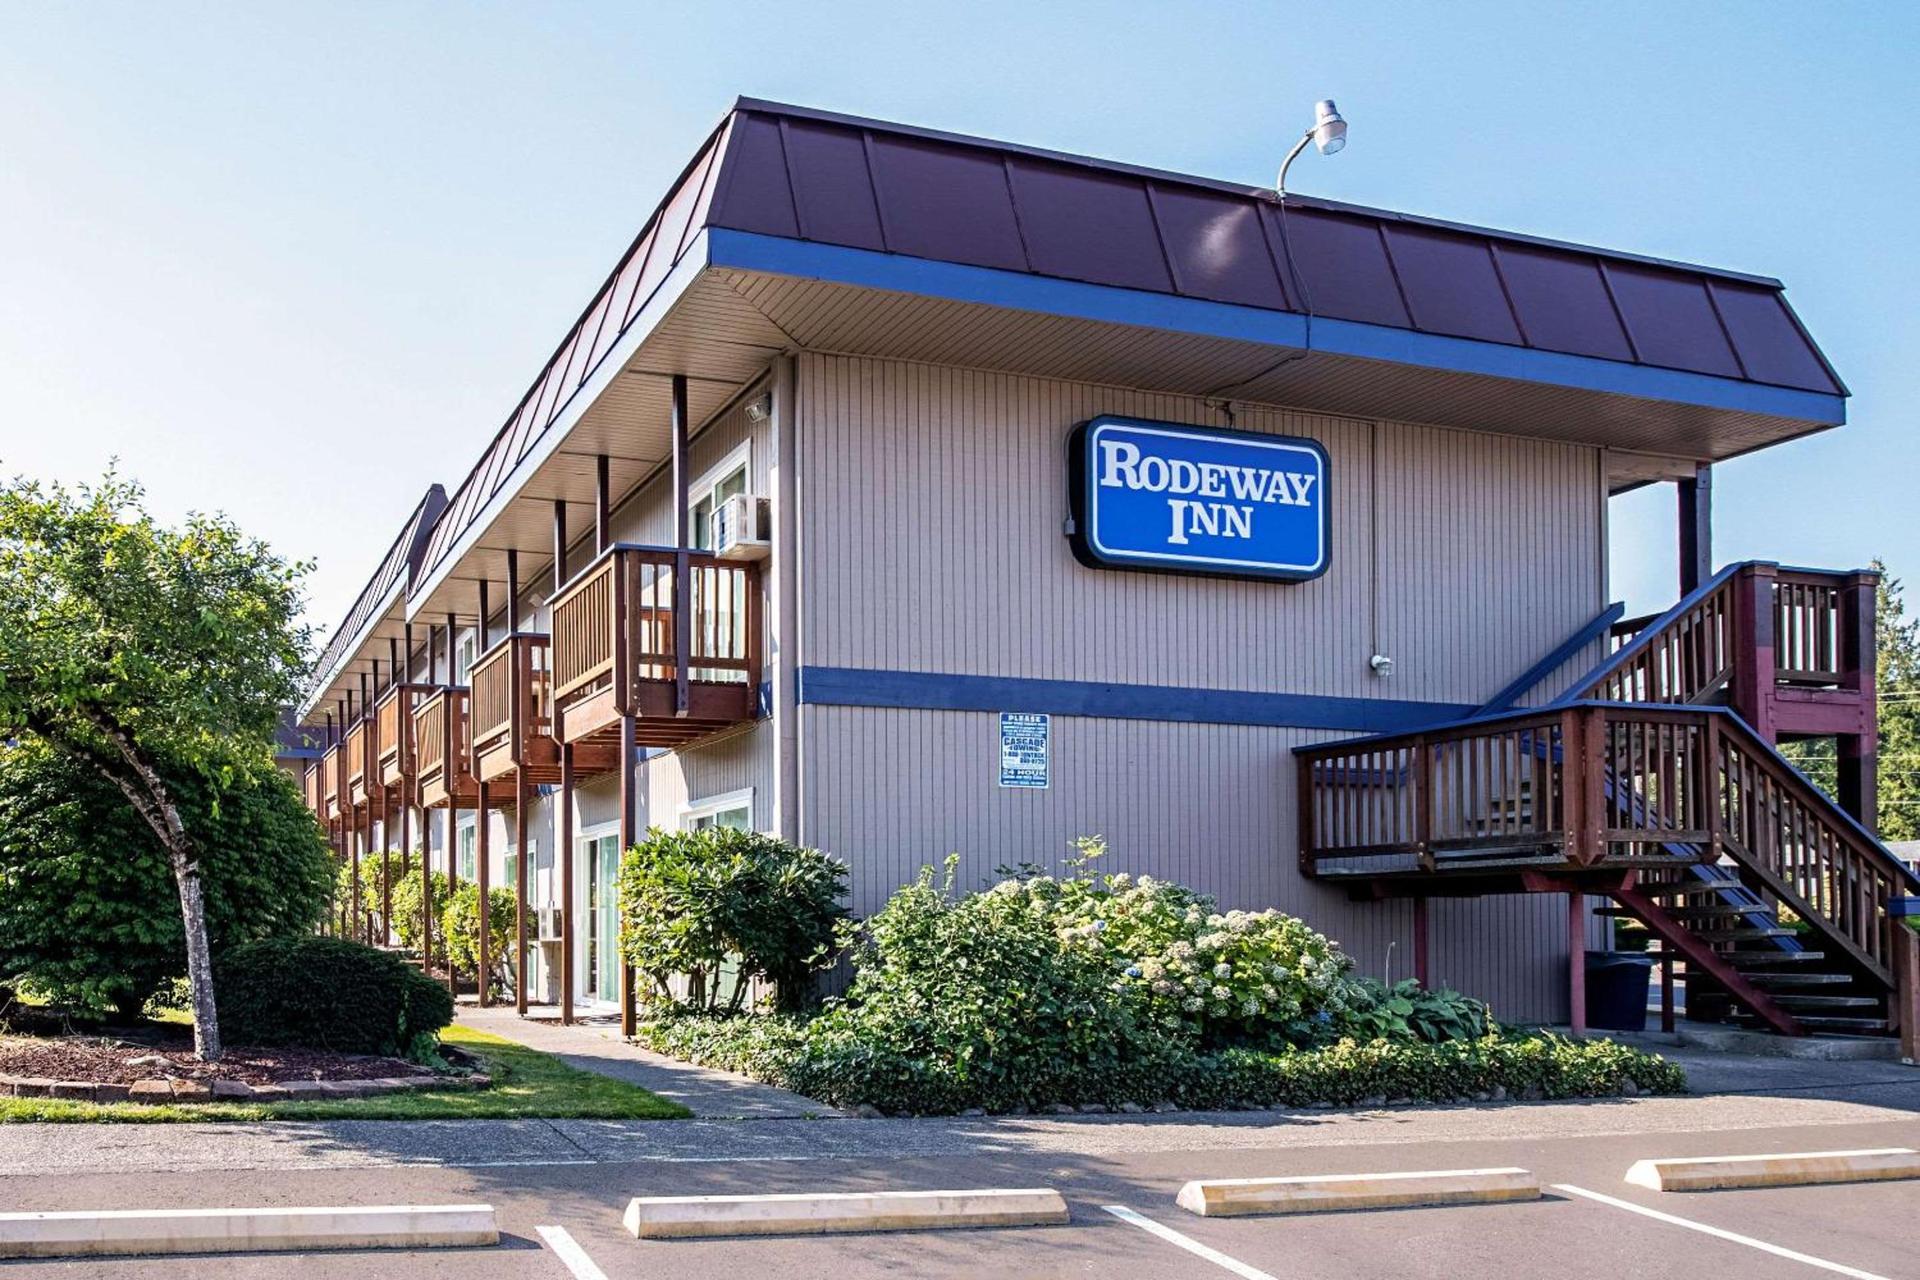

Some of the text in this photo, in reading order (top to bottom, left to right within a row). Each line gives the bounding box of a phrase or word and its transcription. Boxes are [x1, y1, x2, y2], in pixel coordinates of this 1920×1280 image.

[1100, 439, 1316, 506] RODEWAY
[1167, 499, 1254, 545] INN
[1004, 737, 1045, 748] CASCADE
[1017, 769, 1046, 777] HOUR
